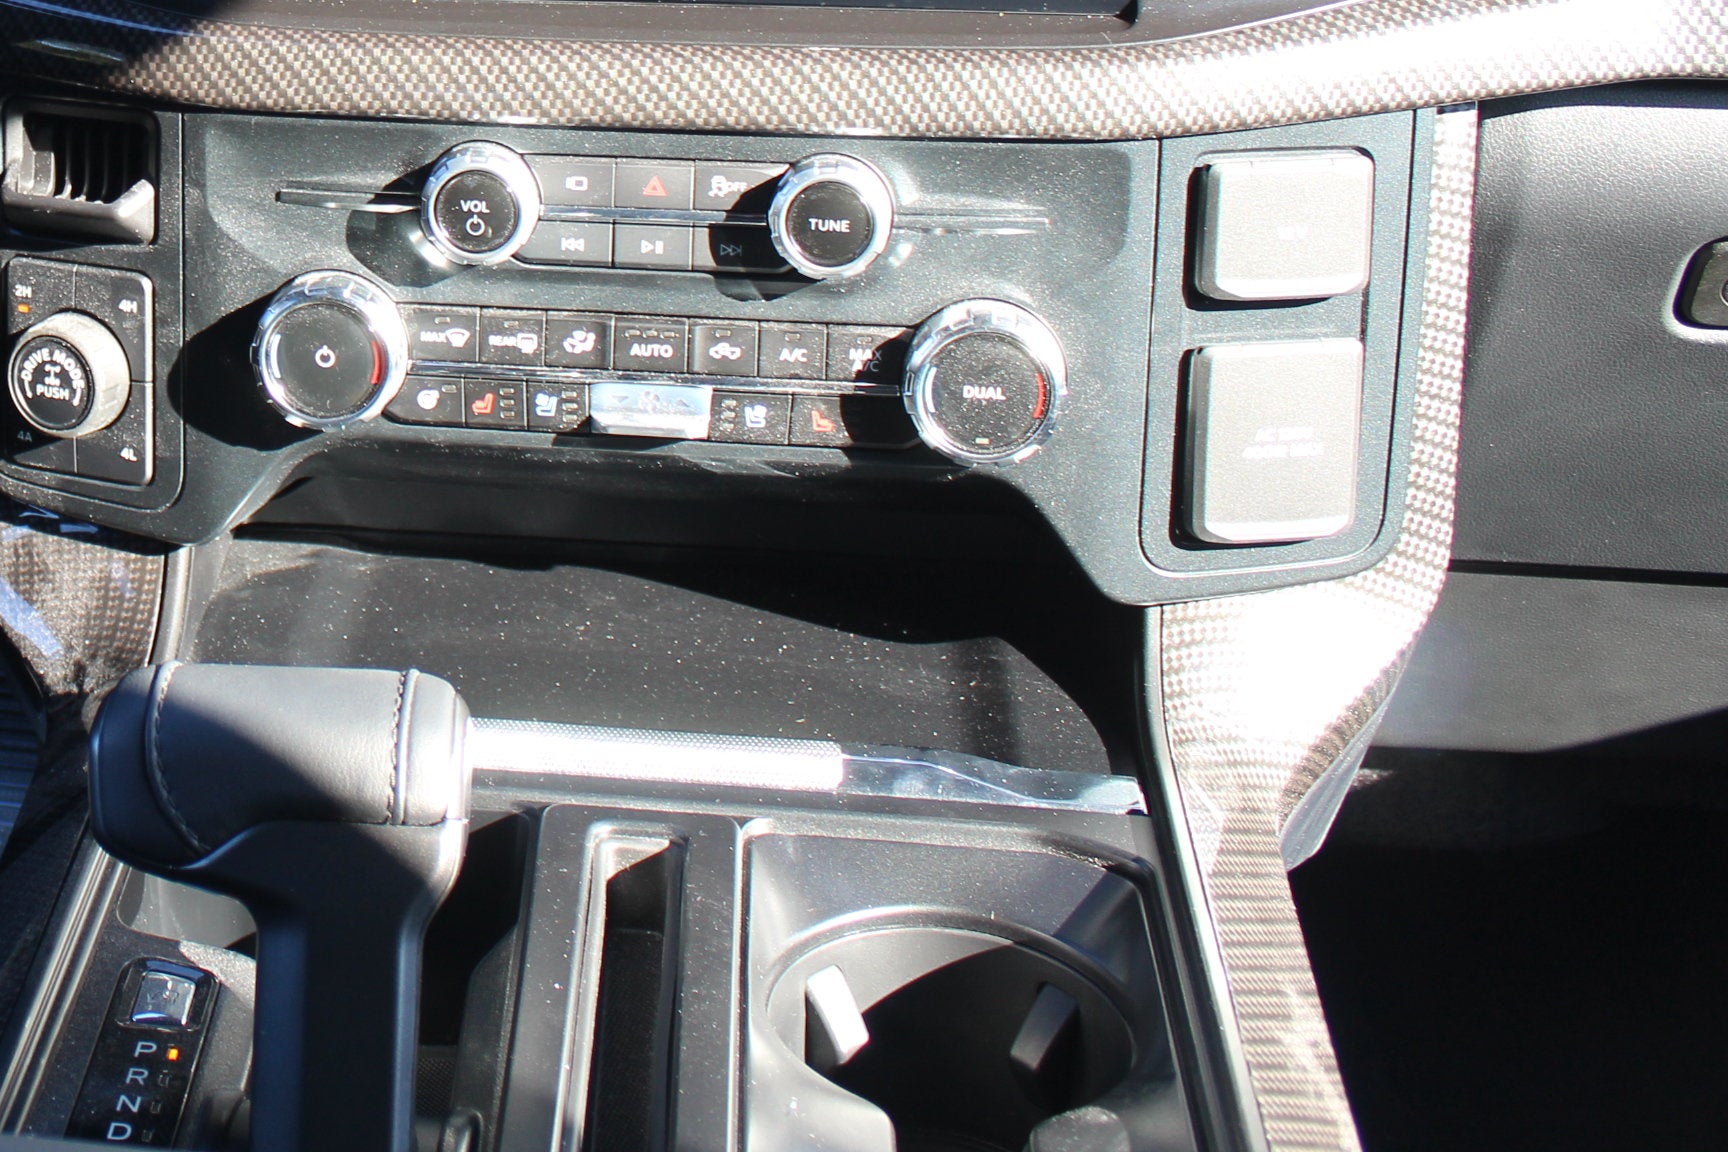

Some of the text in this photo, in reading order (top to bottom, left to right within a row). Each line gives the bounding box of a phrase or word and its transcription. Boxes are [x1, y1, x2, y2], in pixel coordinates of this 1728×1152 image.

[726, 181, 748, 193] OFF
[459, 198, 491, 214] VOL
[808, 217, 851, 234] TUNE
[14, 284, 32, 299] 2H
[118, 298, 138, 314] 4H
[420, 330, 447, 343] MAX
[488, 334, 517, 347] REAR
[629, 343, 674, 359] AUTO
[779, 347, 808, 363] A/C
[849, 348, 883, 360] MAX
[20, 347, 86, 391] DRIVE MODE
[851, 360, 880, 372] A/C
[36, 384, 71, 401] PUSH
[962, 384, 1007, 402] DUAL
[17, 430, 33, 443] 4A
[120, 446, 138, 462] 4L
[133, 1041, 158, 1058] P
[125, 1067, 150, 1085] R
[115, 1094, 142, 1113] N
[106, 1122, 133, 1141] D
